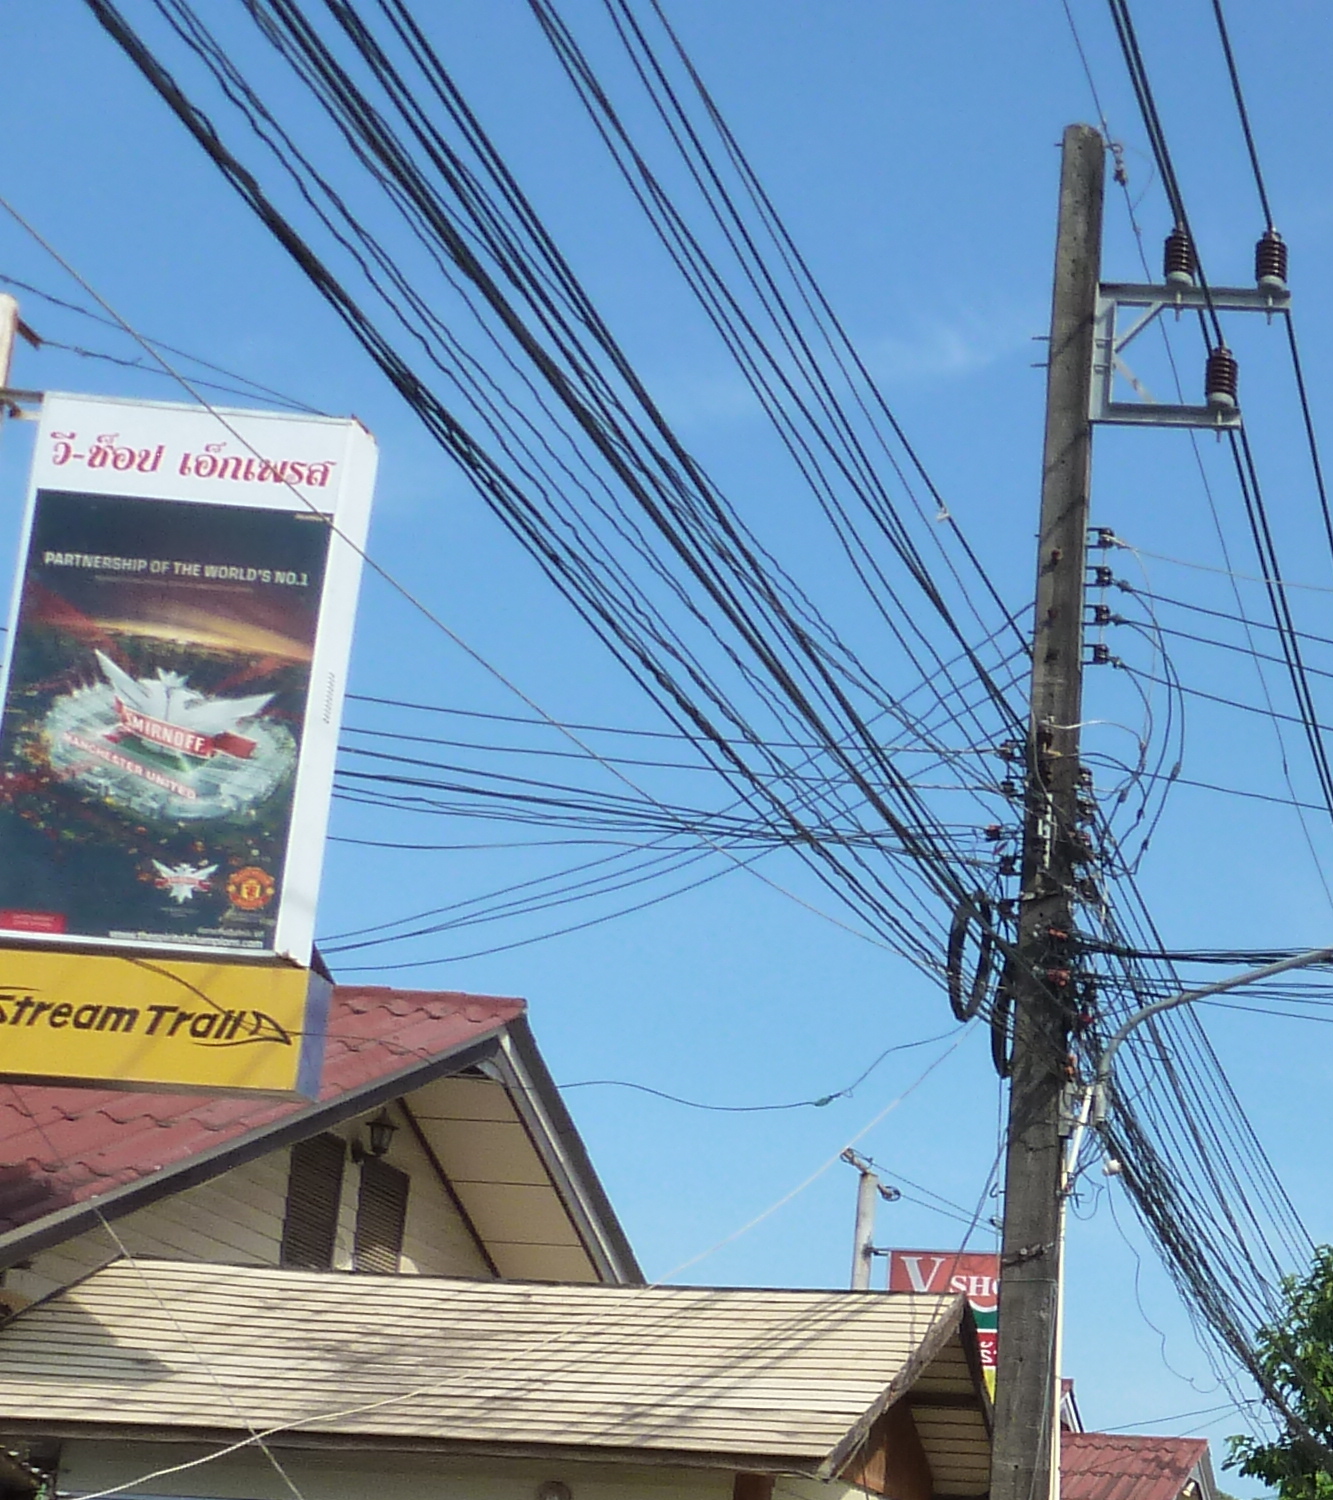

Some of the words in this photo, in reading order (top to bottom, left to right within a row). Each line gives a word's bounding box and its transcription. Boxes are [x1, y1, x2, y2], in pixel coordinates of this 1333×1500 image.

[44, 550, 147, 572] PARTNERSHIP
[150, 562, 170, 575] OF
[174, 562, 200, 576] THE
[204, 564, 272, 582] WORLD'S
[275, 570, 309, 586] NO.1
[125, 712, 207, 752] SMIRNOFF
[62, 731, 143, 776] MANCHESTER
[147, 770, 197, 800] UNITED
